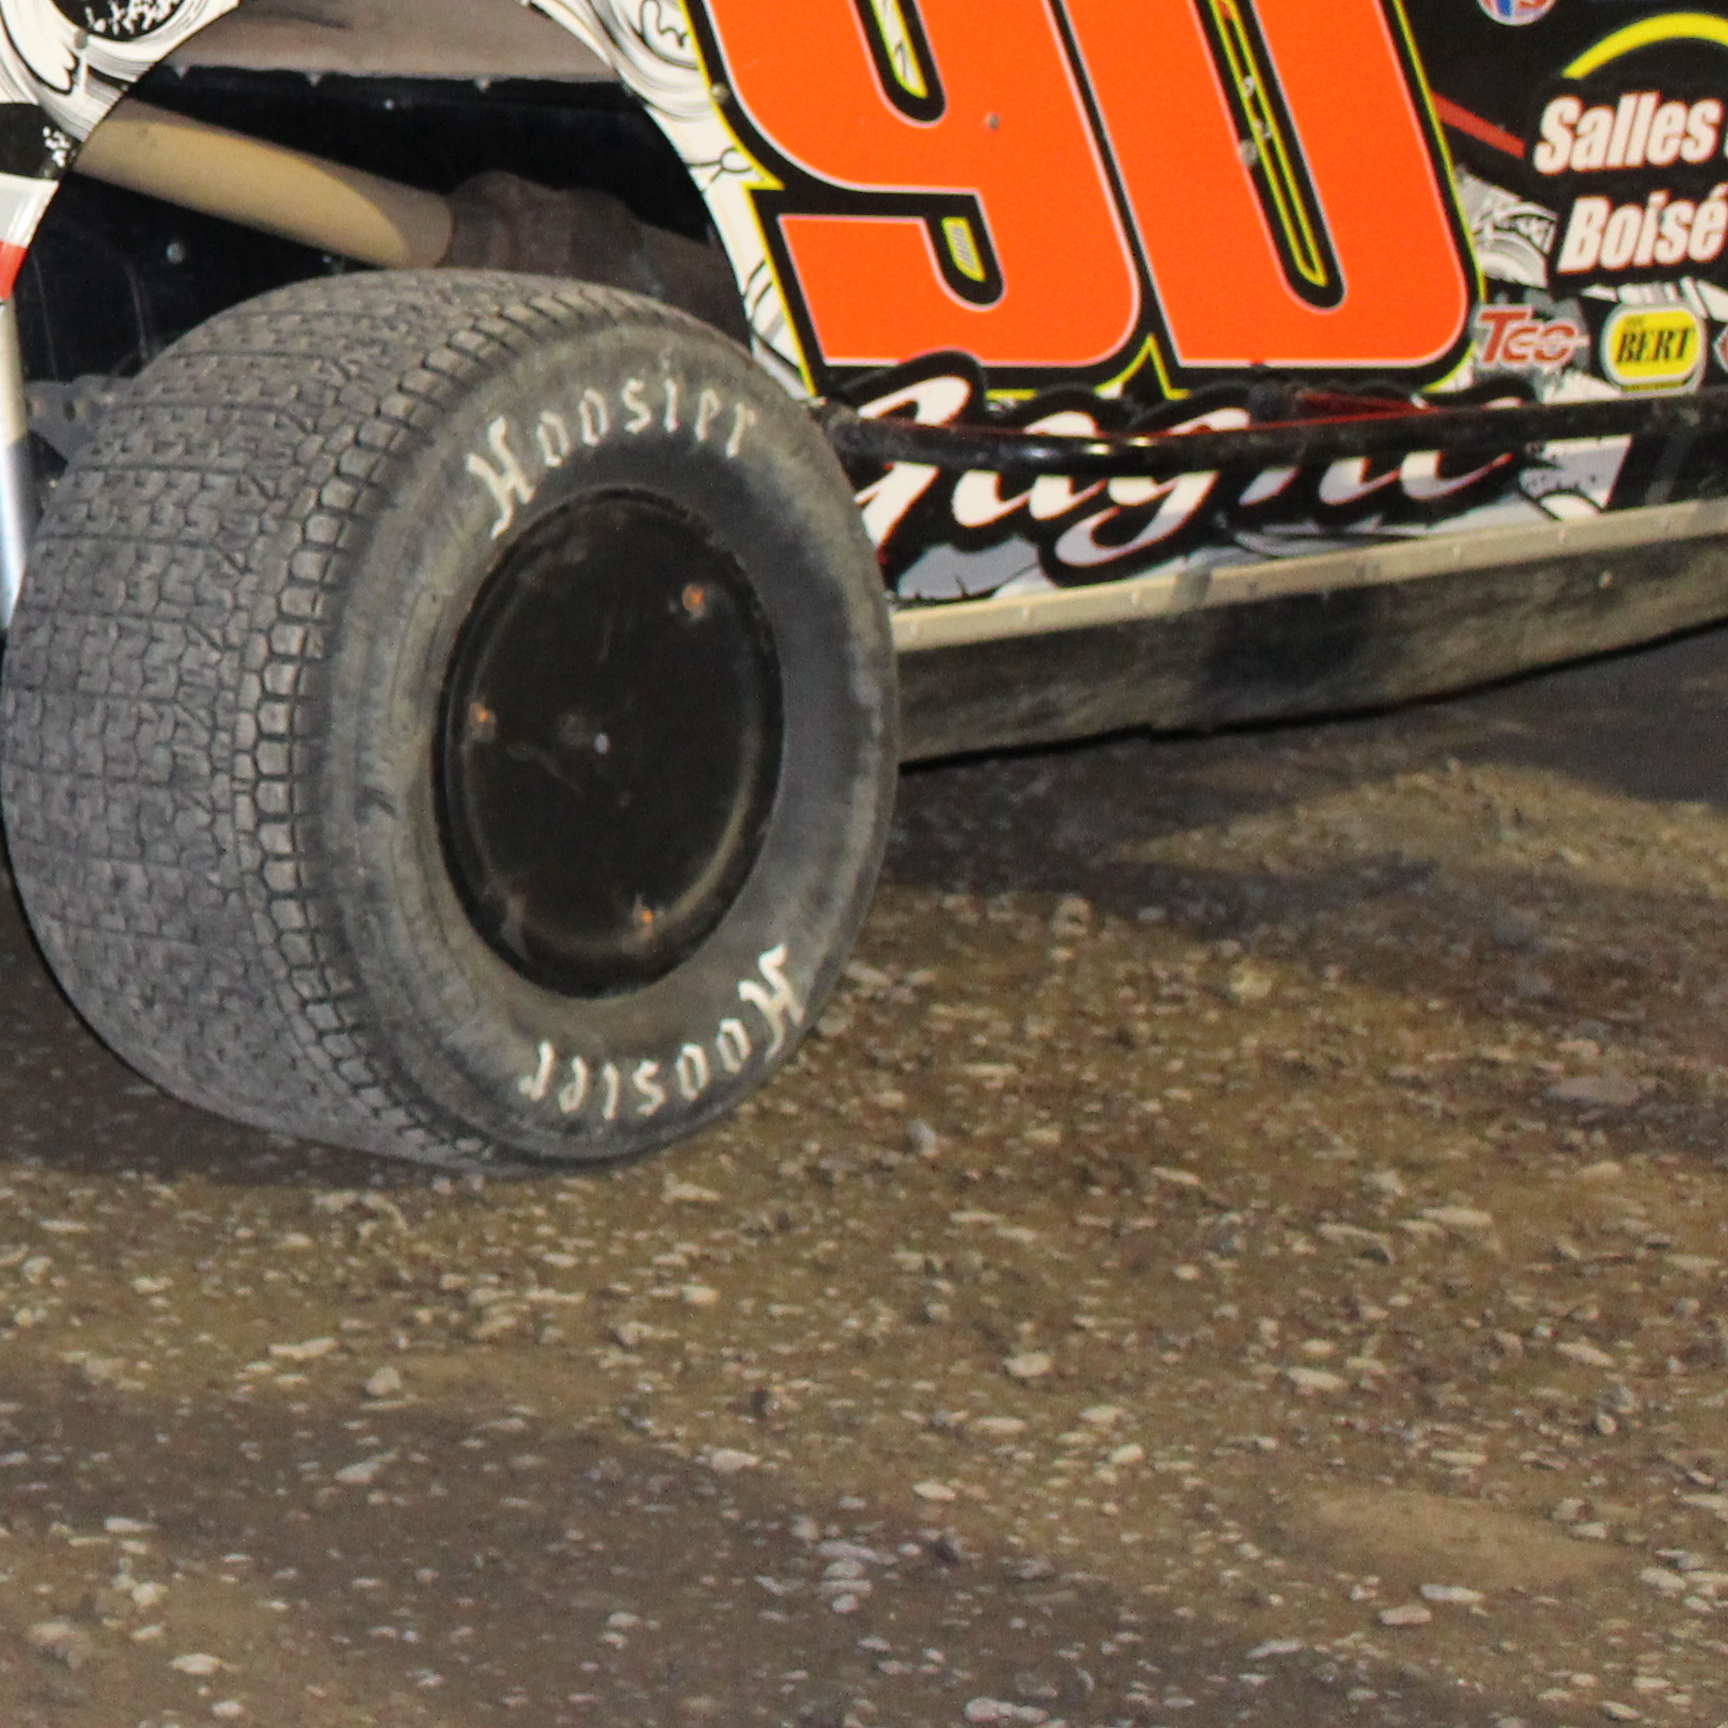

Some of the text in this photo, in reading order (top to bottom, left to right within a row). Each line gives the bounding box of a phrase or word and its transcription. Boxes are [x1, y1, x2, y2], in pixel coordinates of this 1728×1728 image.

[1532, 90, 1724, 176] Salles
[1555, 182, 1728, 275] Boisé
[1615, 327, 1694, 364] BERT
